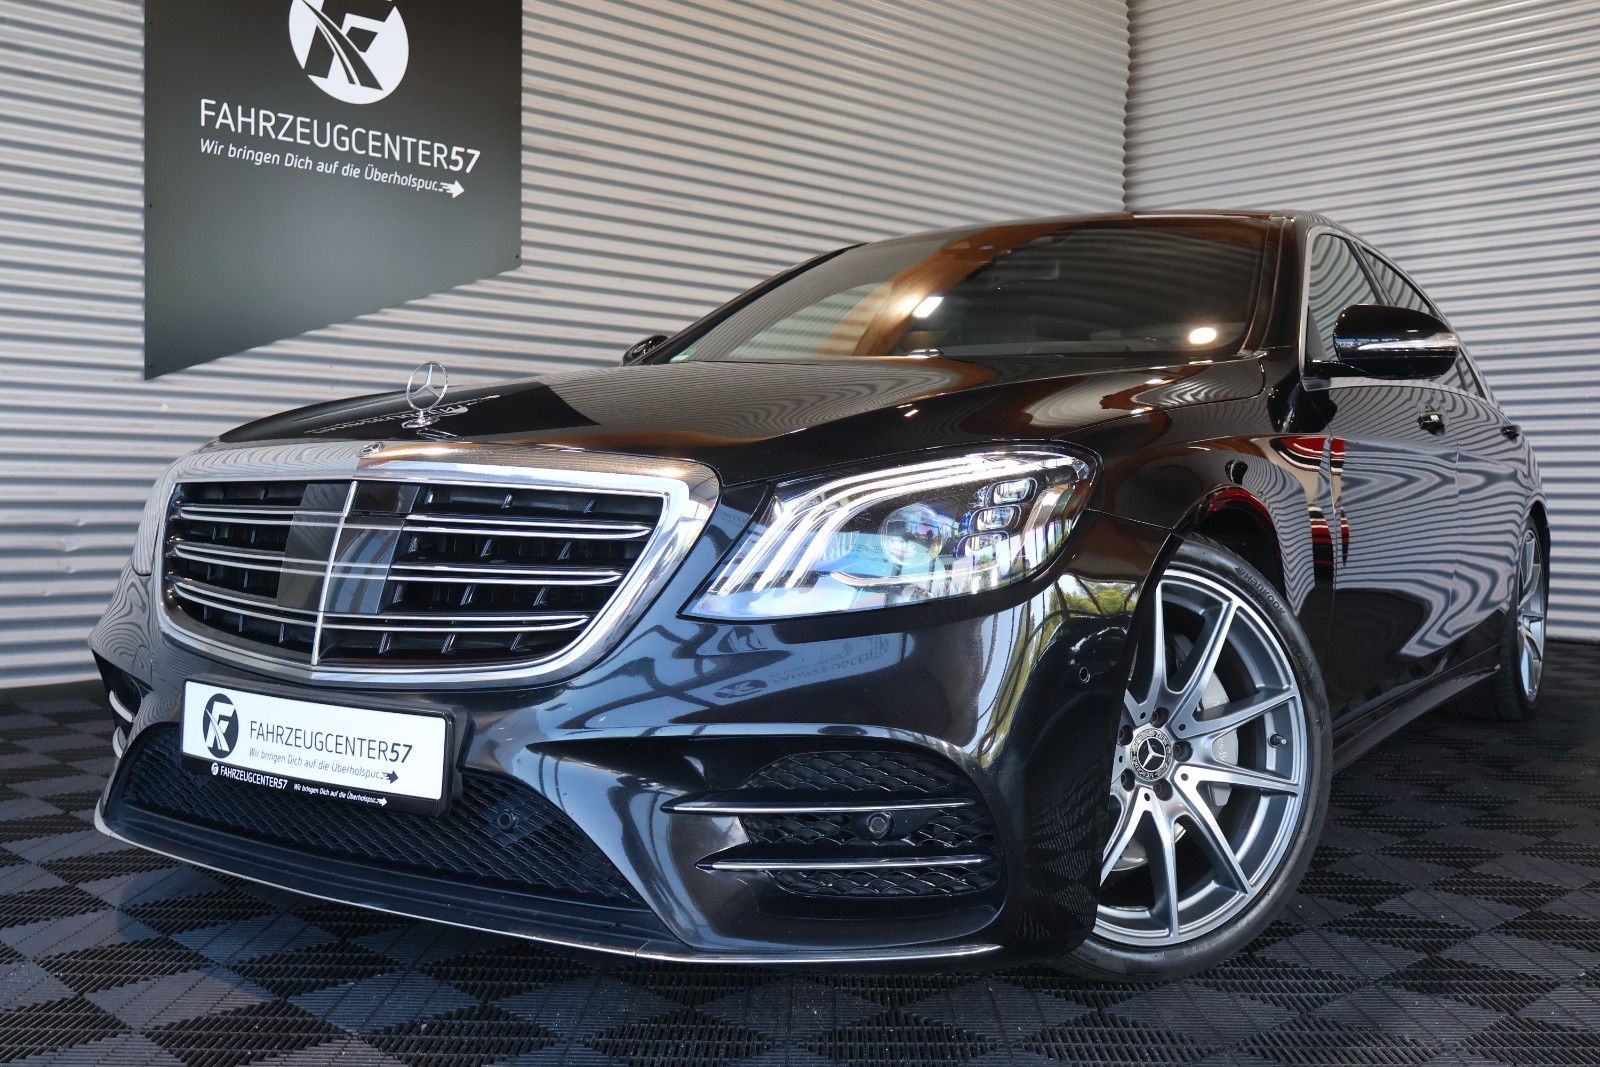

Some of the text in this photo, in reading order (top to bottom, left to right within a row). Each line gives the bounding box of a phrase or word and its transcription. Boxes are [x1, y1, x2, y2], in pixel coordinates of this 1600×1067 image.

[200, 98, 481, 174] FAHRZEUGCENTER57
[200, 138, 224, 156] Wir
[227, 143, 280, 166] bringen
[284, 152, 313, 171] Dich
[316, 161, 339, 175] auf
[341, 162, 361, 178] die
[249, 720, 413, 764] FAHRZEUGCENTER57
[249, 747, 260, 757] Wir
[260, 749, 286, 764] bringen
[287, 754, 303, 766] Dich
[304, 758, 317, 769] auf
[318, 760, 330, 771] die
[220, 765, 288, 790] FAHRZEUGCENTER57
